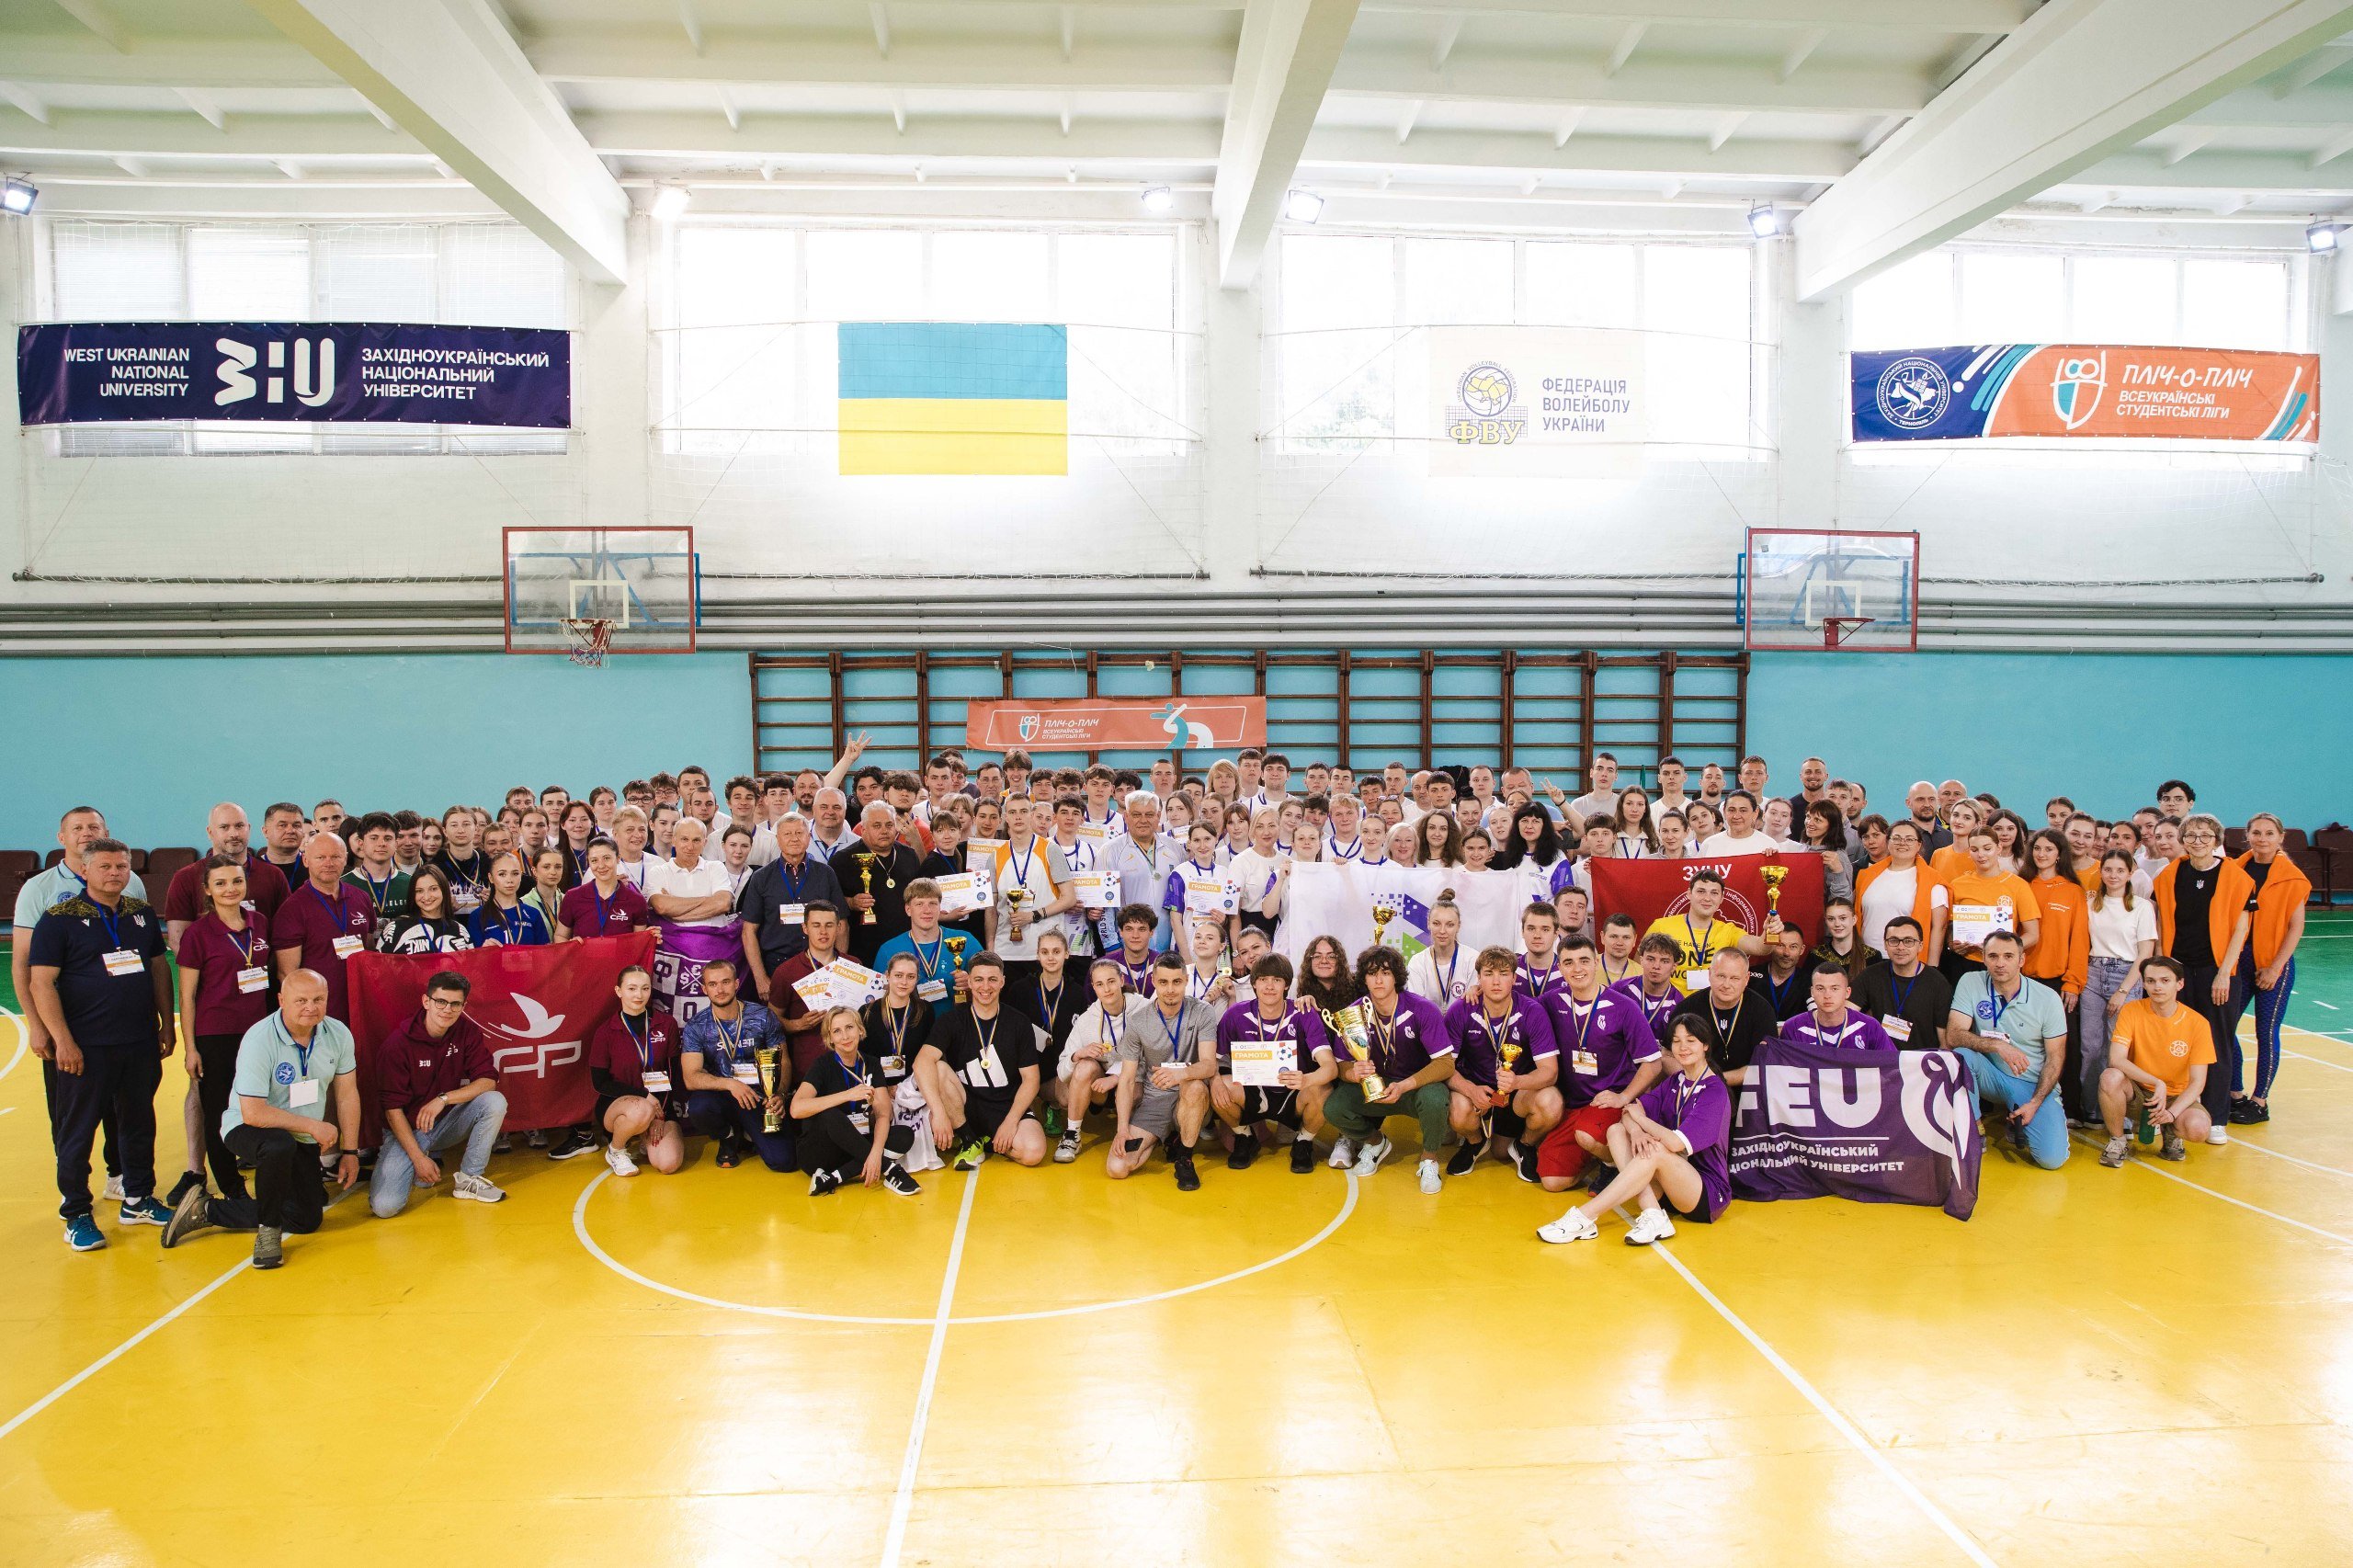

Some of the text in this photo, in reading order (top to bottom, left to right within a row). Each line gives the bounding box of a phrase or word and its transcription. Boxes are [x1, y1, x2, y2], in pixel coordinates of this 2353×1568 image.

[64, 347, 189, 362] WEST UKRAINIAN
[362, 347, 550, 368] ЗАХІДНОУКРАЇНСЬКИЙ
[111, 365, 189, 380] NATIONAL
[362, 366, 494, 383] НАЦІОНАЛЬНИЙ
[2121, 364, 2254, 389] ПЛІЧ-О-ПЛІЧ
[100, 382, 189, 397] UNIVERSITY
[363, 383, 476, 400] УНІВЕРСИТЕТ
[1541, 377, 1626, 394] ФЕДЕРАЦІЯ
[1542, 395, 1630, 414] ВОЛЕЙБОЛУ
[2119, 390, 2215, 405] ВСЕУКРАЇНСЬКІ
[2116, 404, 2230, 419] СТУДЕНТСЬКІ ЛІГИ
[1449, 419, 1525, 444] ФВУ
[1542, 415, 1605, 432] УКРАЇНИ
[404, 937, 430, 955] NIKE
[1732, 1140, 1879, 1157] ЗАХІДНОУКРАЇНСЬКИЙ
[1729, 1155, 1904, 1174] ЦІОНАЛЬНИЙ УНІВЕРСИТЕТ
